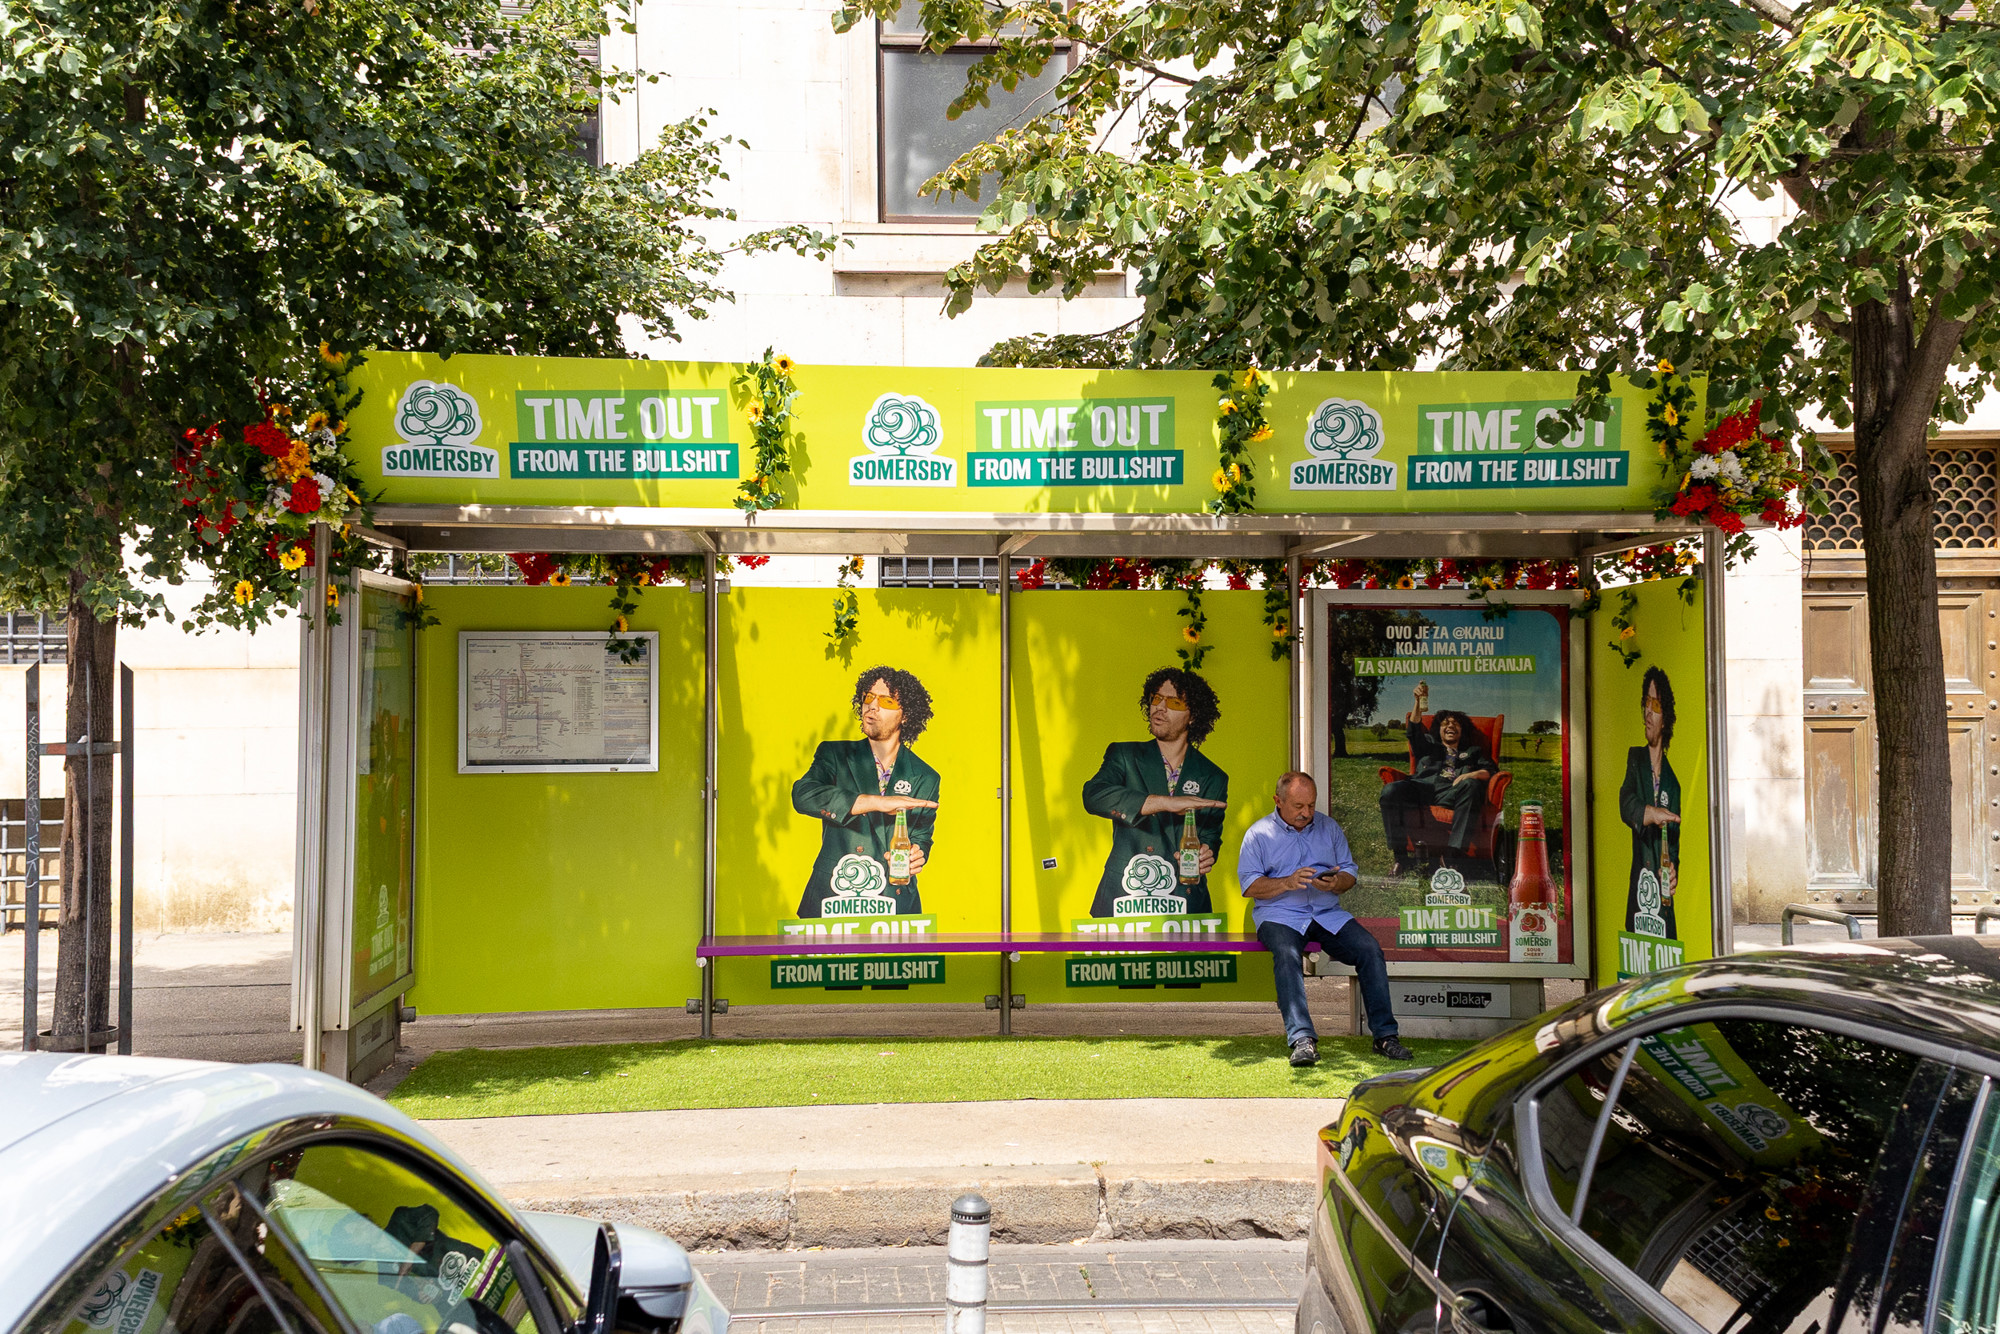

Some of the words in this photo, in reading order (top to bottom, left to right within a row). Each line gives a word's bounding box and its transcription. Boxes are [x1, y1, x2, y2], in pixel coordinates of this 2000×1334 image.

[524, 397, 627, 440] TIME
[639, 397, 720, 441] OUT
[982, 406, 1079, 450] TIME
[1090, 405, 1168, 448] OUT
[1426, 408, 1523, 453] TIME
[386, 449, 494, 472] SOMERSBY
[518, 450, 578, 471] FROM
[585, 450, 626, 471] THE
[633, 450, 731, 472] BULLSHIT
[854, 459, 952, 480] SOMERSBY
[975, 459, 1030, 480] FROM
[1037, 458, 1075, 480] THE
[1082, 457, 1175, 479] BULLSHIT
[1416, 461, 1472, 483] FROM
[1479, 460, 1518, 481] THE
[1524, 458, 1620, 480] BULLSHIT
[1294, 463, 1393, 484] SOMERSBY
[1386, 625, 1412, 640] OVO
[1414, 626, 1430, 640] JE
[1432, 626, 1449, 639] ZA
[1452, 626, 1505, 640] @KARLU
[1395, 642, 1429, 656] KOJA
[1432, 642, 1457, 656] IMA
[1460, 642, 1494, 656] PLAN
[1358, 660, 1375, 674] ZA
[1377, 660, 1420, 674] SVAKU
[1421, 659, 1471, 673] MINUTU
[1475, 655, 1533, 672] ČEKANJA
[824, 898, 893, 914] SOMERSBY
[1116, 898, 1183, 913] SOMERSBY
[1427, 894, 1470, 905] SOMERSBY
[1403, 909, 1449, 930] TIME
[1457, 908, 1493, 929] OUT
[1635, 916, 1665, 936] SOMERSBY
[1399, 932, 1427, 945] FROM
[1429, 932, 1448, 945] THE
[1452, 932, 1498, 945] BULLSHIT
[1515, 937, 1553, 947] SOMERSBY
[1620, 937, 1651, 975] TIME
[777, 964, 822, 982] FROM
[828, 963, 858, 981] THE
[864, 961, 938, 979] BULLSHIT
[1072, 963, 1116, 981] FROM
[1121, 962, 1151, 979] THE
[1156, 960, 1230, 978] BULLSHIT
[1403, 992, 1446, 1005] zagreb
[1451, 992, 1486, 1006] plakat
